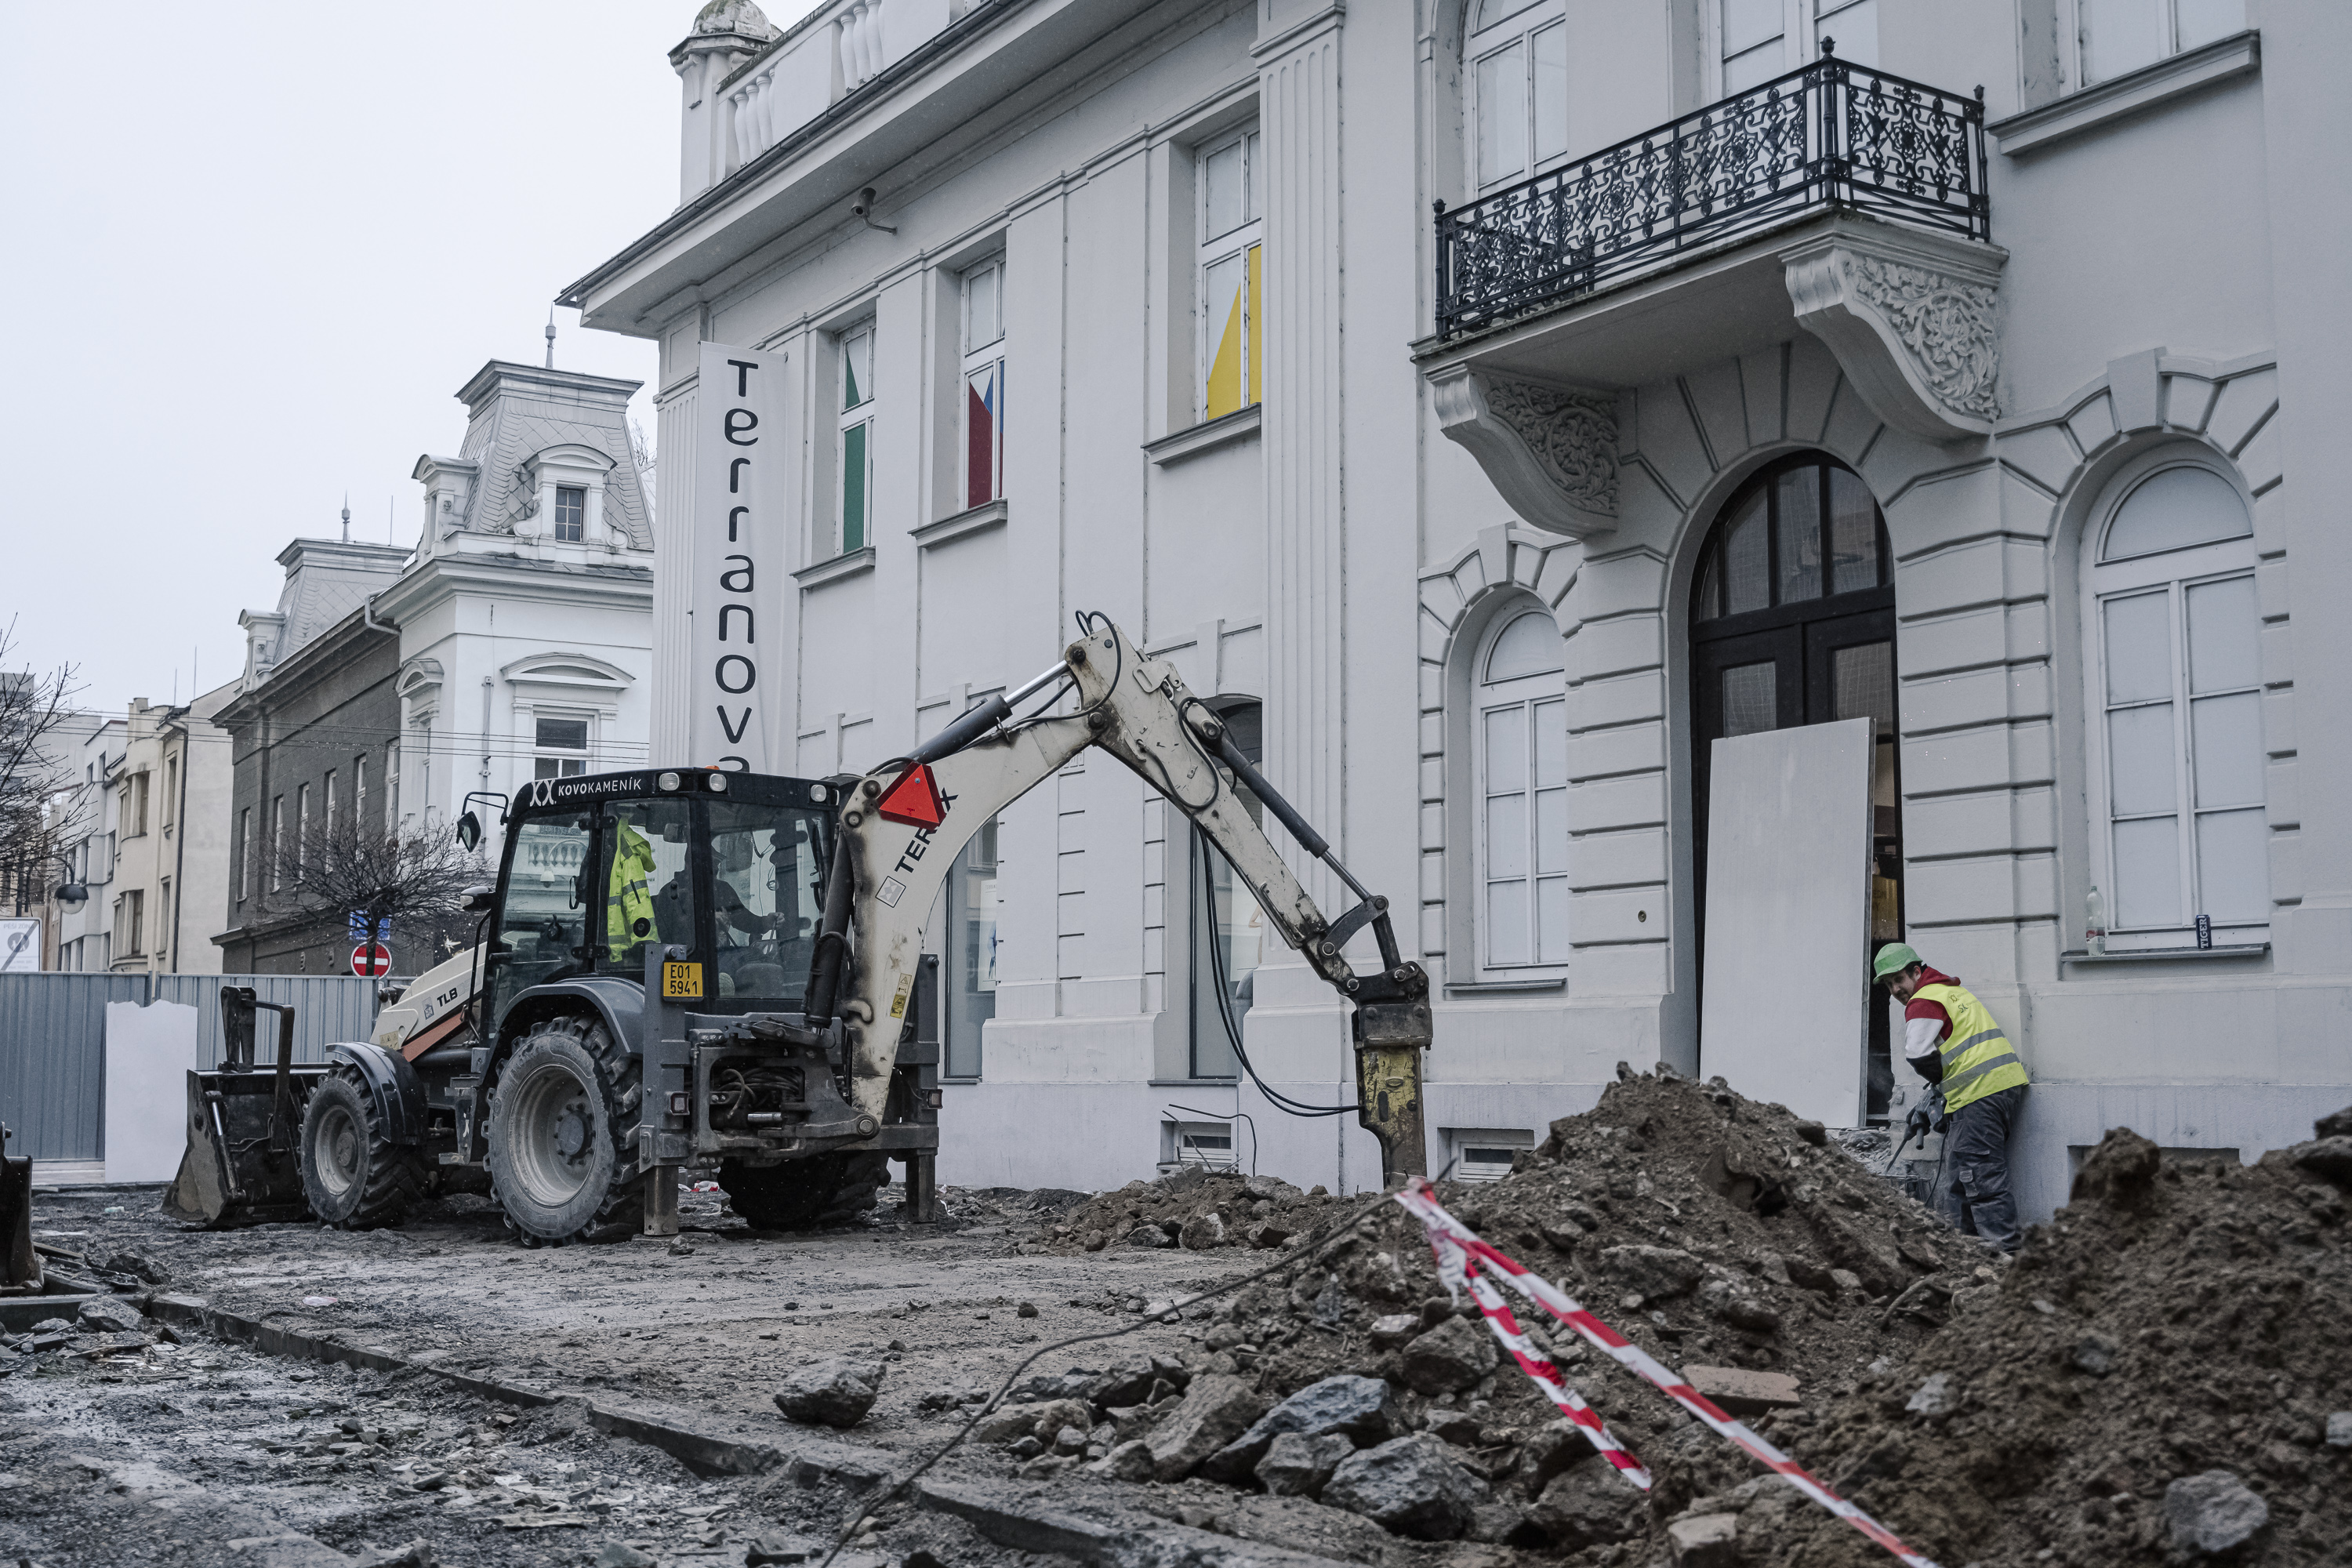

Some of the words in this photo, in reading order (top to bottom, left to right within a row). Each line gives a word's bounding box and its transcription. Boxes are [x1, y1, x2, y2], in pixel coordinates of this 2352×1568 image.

[558, 776, 642, 797] KOVOKAMENÍK
[894, 786, 960, 873] TERX
[2198, 917, 2209, 949] TIGER
[670, 964, 690, 978] E01
[437, 987, 458, 1007] TLB
[670, 980, 698, 995] 5941
